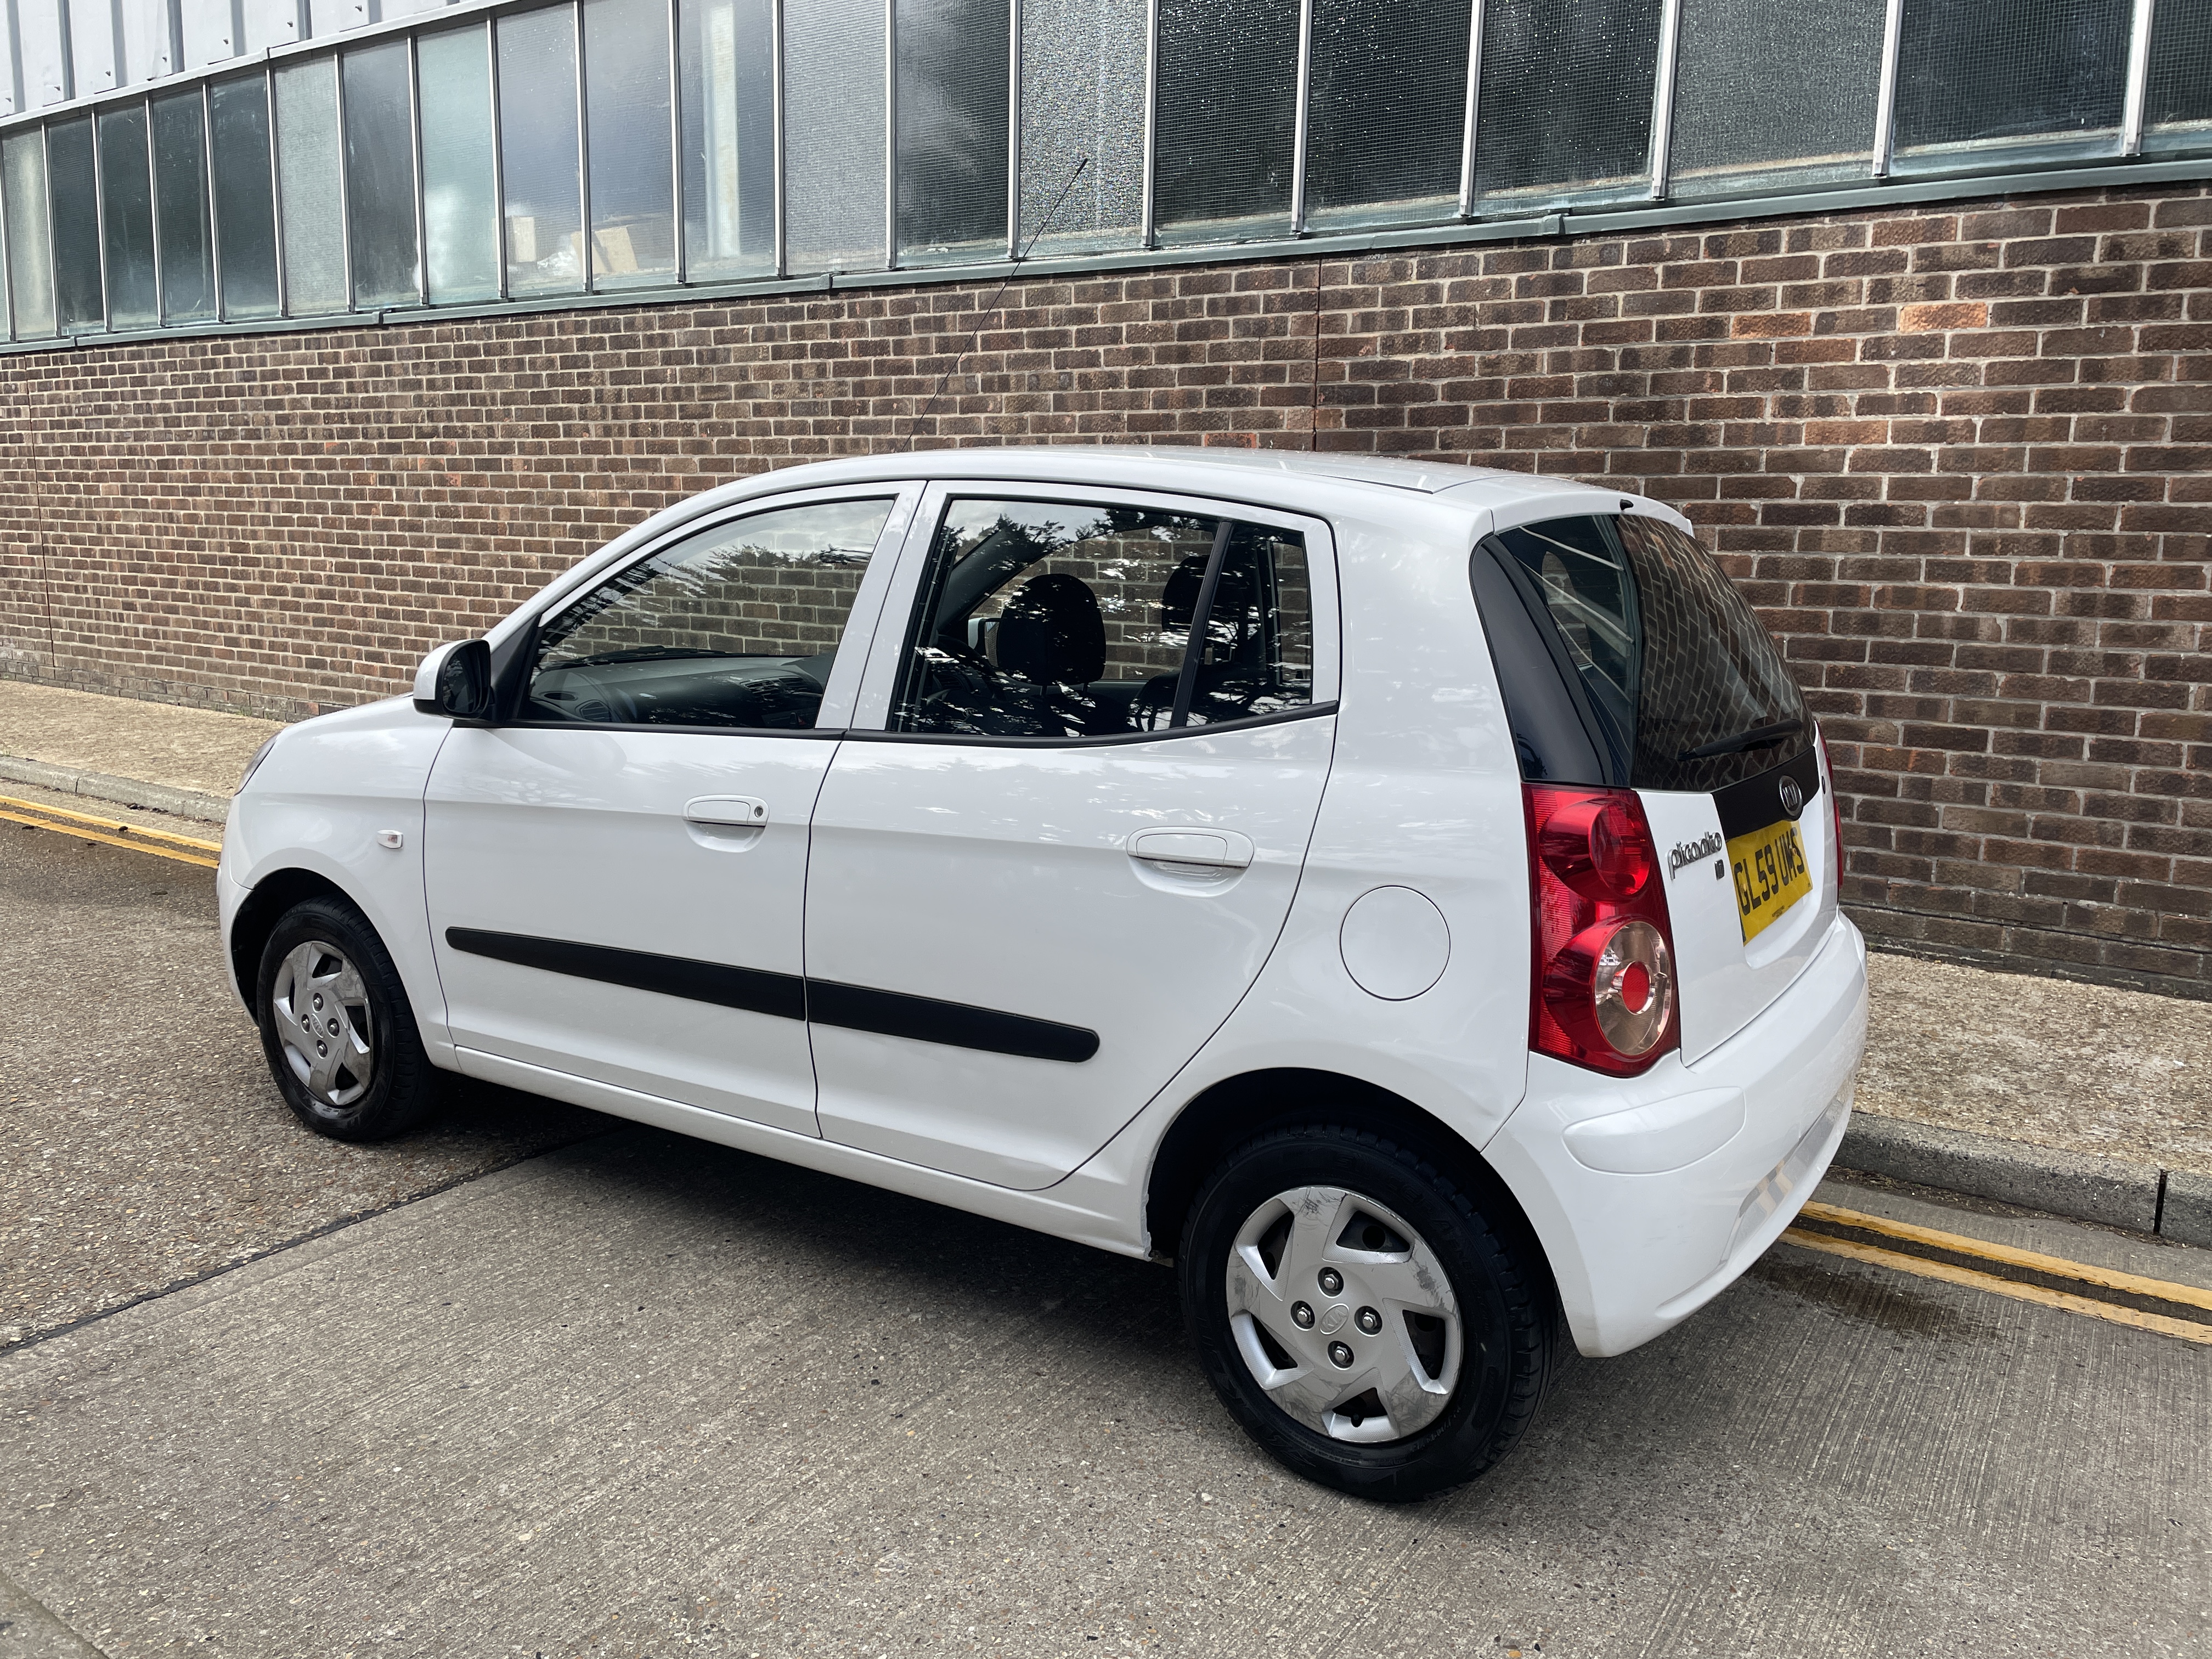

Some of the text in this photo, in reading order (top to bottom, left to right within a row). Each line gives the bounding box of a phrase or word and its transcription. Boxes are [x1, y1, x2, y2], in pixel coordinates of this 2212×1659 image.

[1667, 831, 1722, 881] picanto
[1734, 827, 1805, 916] GL59 UMS
[1322, 1308, 1348, 1331] KIA
